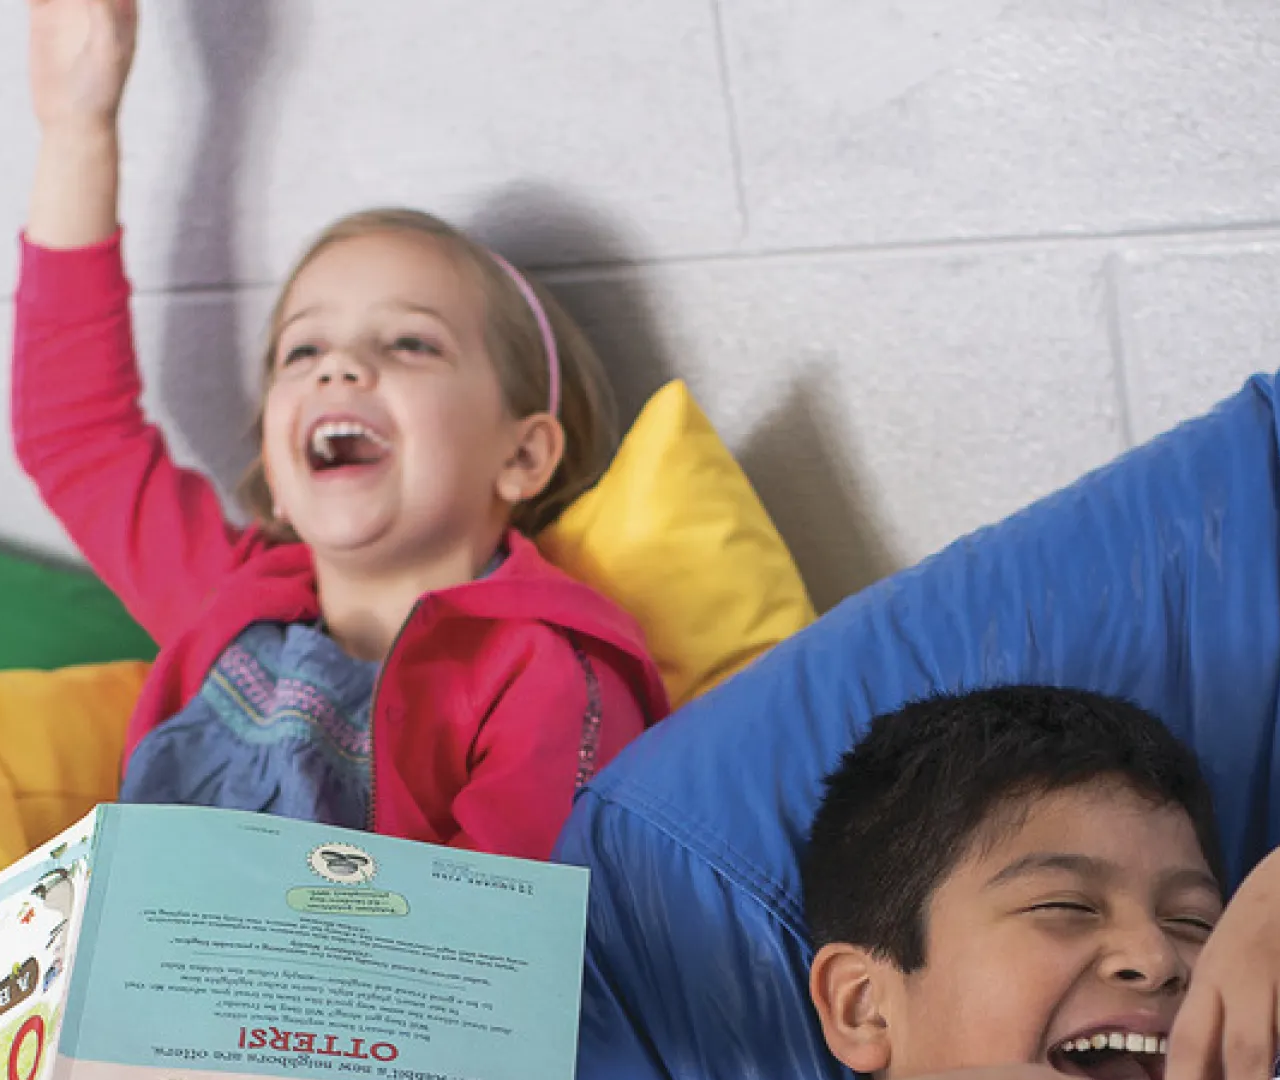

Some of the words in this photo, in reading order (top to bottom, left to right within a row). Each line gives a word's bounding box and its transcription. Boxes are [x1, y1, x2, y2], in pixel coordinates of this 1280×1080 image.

[17, 971, 30, 992] A
[239, 1028, 398, 1061] OTTERS!
[152, 1047, 209, 1061] otters.
[213, 1051, 242, 1062] are
[247, 1053, 332, 1069] neighbors
[338, 1062, 372, 1074] new
